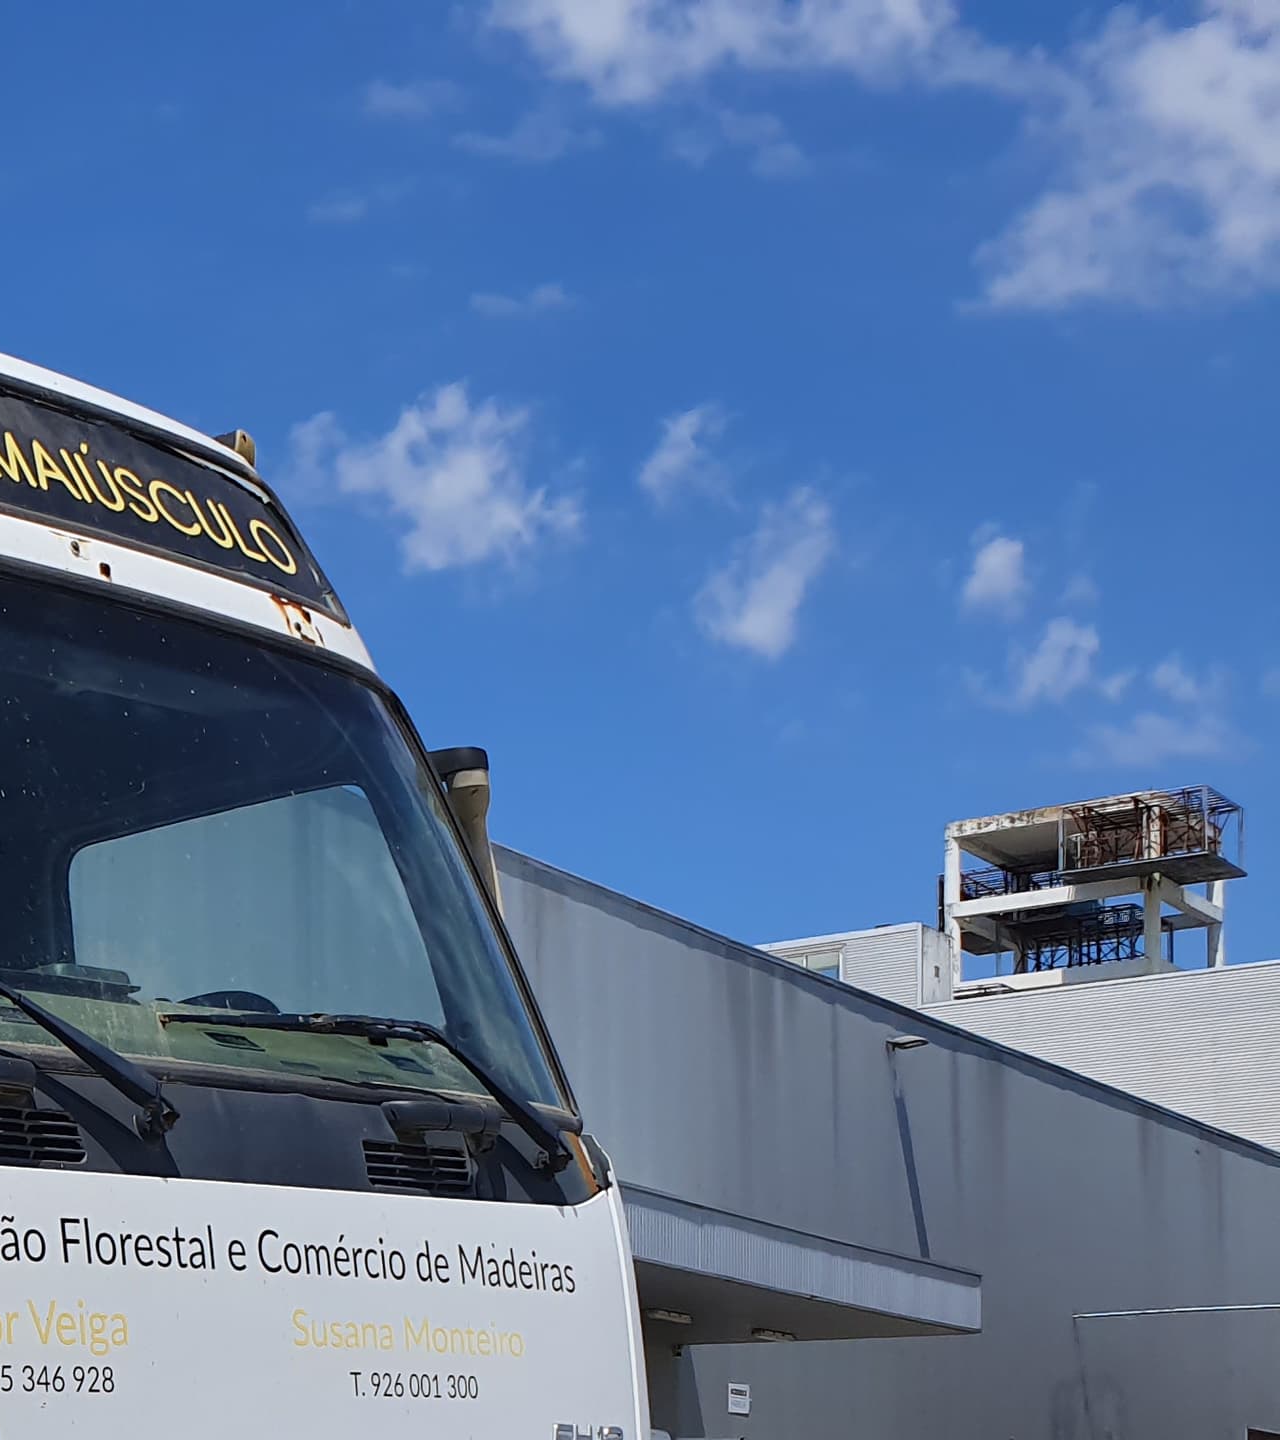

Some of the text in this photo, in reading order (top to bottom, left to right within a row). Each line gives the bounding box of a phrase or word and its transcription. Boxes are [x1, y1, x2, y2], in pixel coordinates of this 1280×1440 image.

[60, 1216, 216, 1270] Florestal
[228, 1238, 247, 1272] e
[257, 1229, 406, 1281] Comércio
[415, 1241, 451, 1284] de
[457, 1242, 576, 1294] Madeiras
[27, 1299, 130, 1357] Veiga
[292, 1308, 525, 1358] Susana Monteiro
[21, 1365, 67, 1393] 346
[72, 1366, 115, 1393] 928
[350, 1371, 479, 1400] T. 926 001 300
